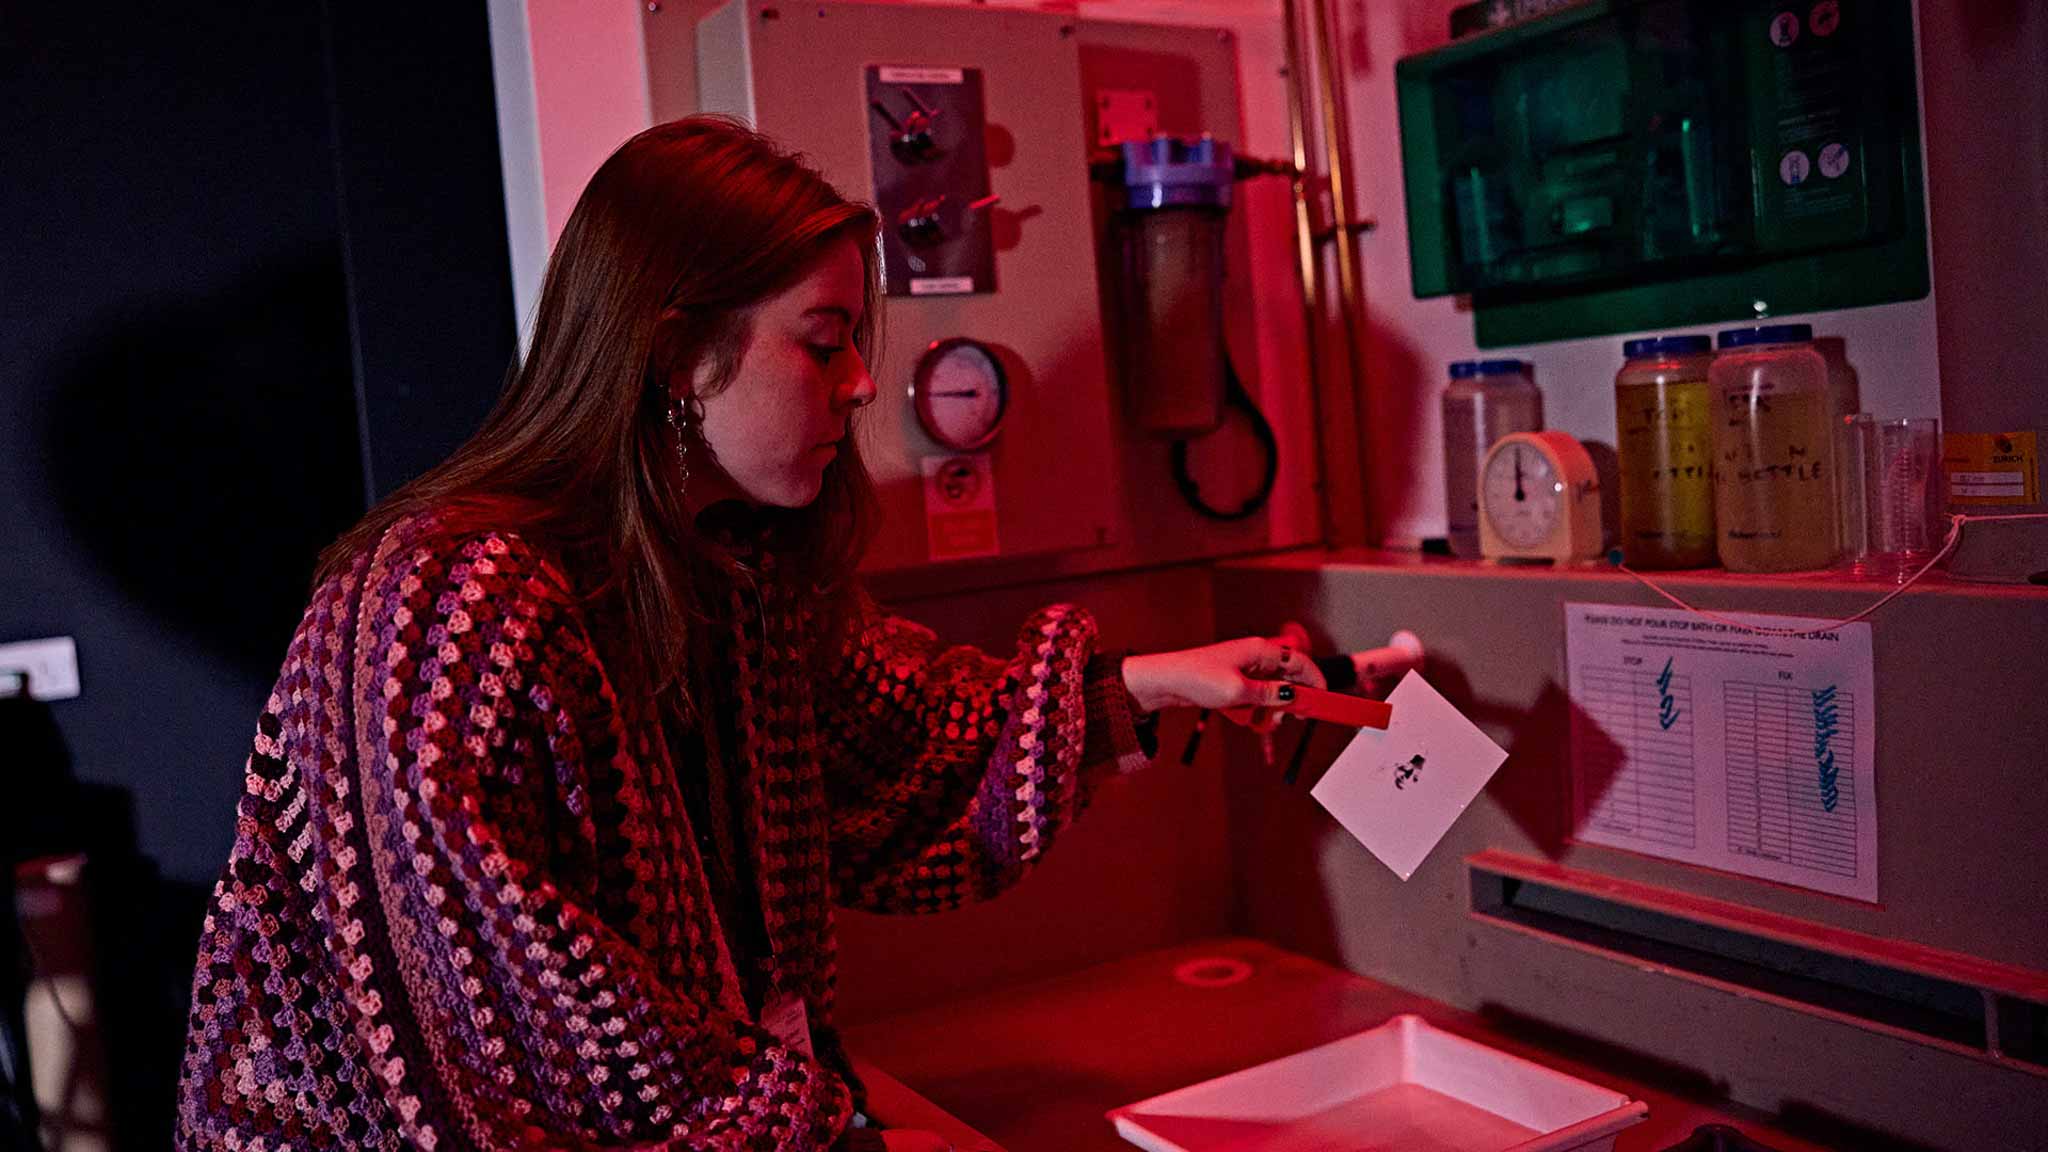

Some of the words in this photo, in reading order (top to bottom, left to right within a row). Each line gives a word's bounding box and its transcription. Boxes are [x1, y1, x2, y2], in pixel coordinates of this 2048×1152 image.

[1992, 455, 2024, 464] ZURICH
[1645, 618, 1667, 629] POUR
[1669, 619, 1689, 630] STOP
[1691, 621, 1713, 632] BATH
[1808, 631, 1839, 642] DRAIN
